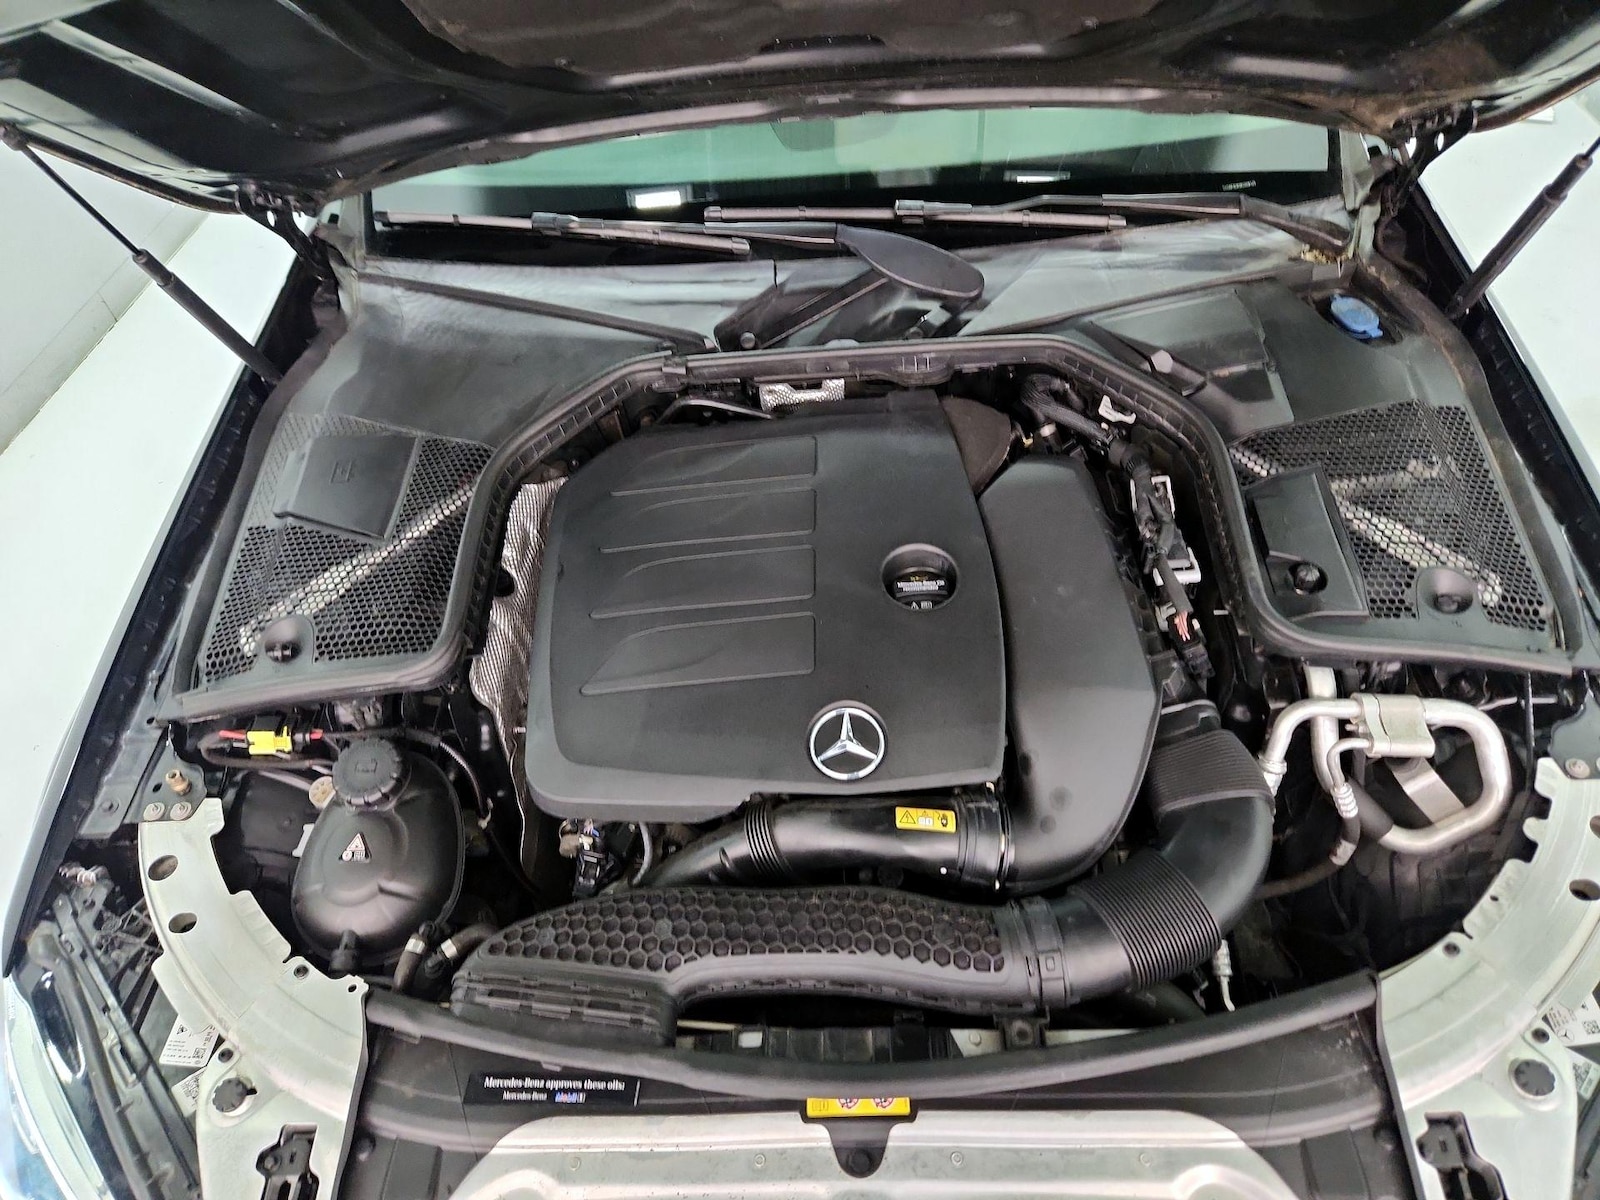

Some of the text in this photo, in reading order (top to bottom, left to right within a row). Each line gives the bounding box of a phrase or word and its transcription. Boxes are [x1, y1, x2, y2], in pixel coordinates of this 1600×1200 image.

[484, 1075, 545, 1089] Mercedes-Benz
[545, 1078, 583, 1091] approves
[584, 1078, 606, 1089] these
